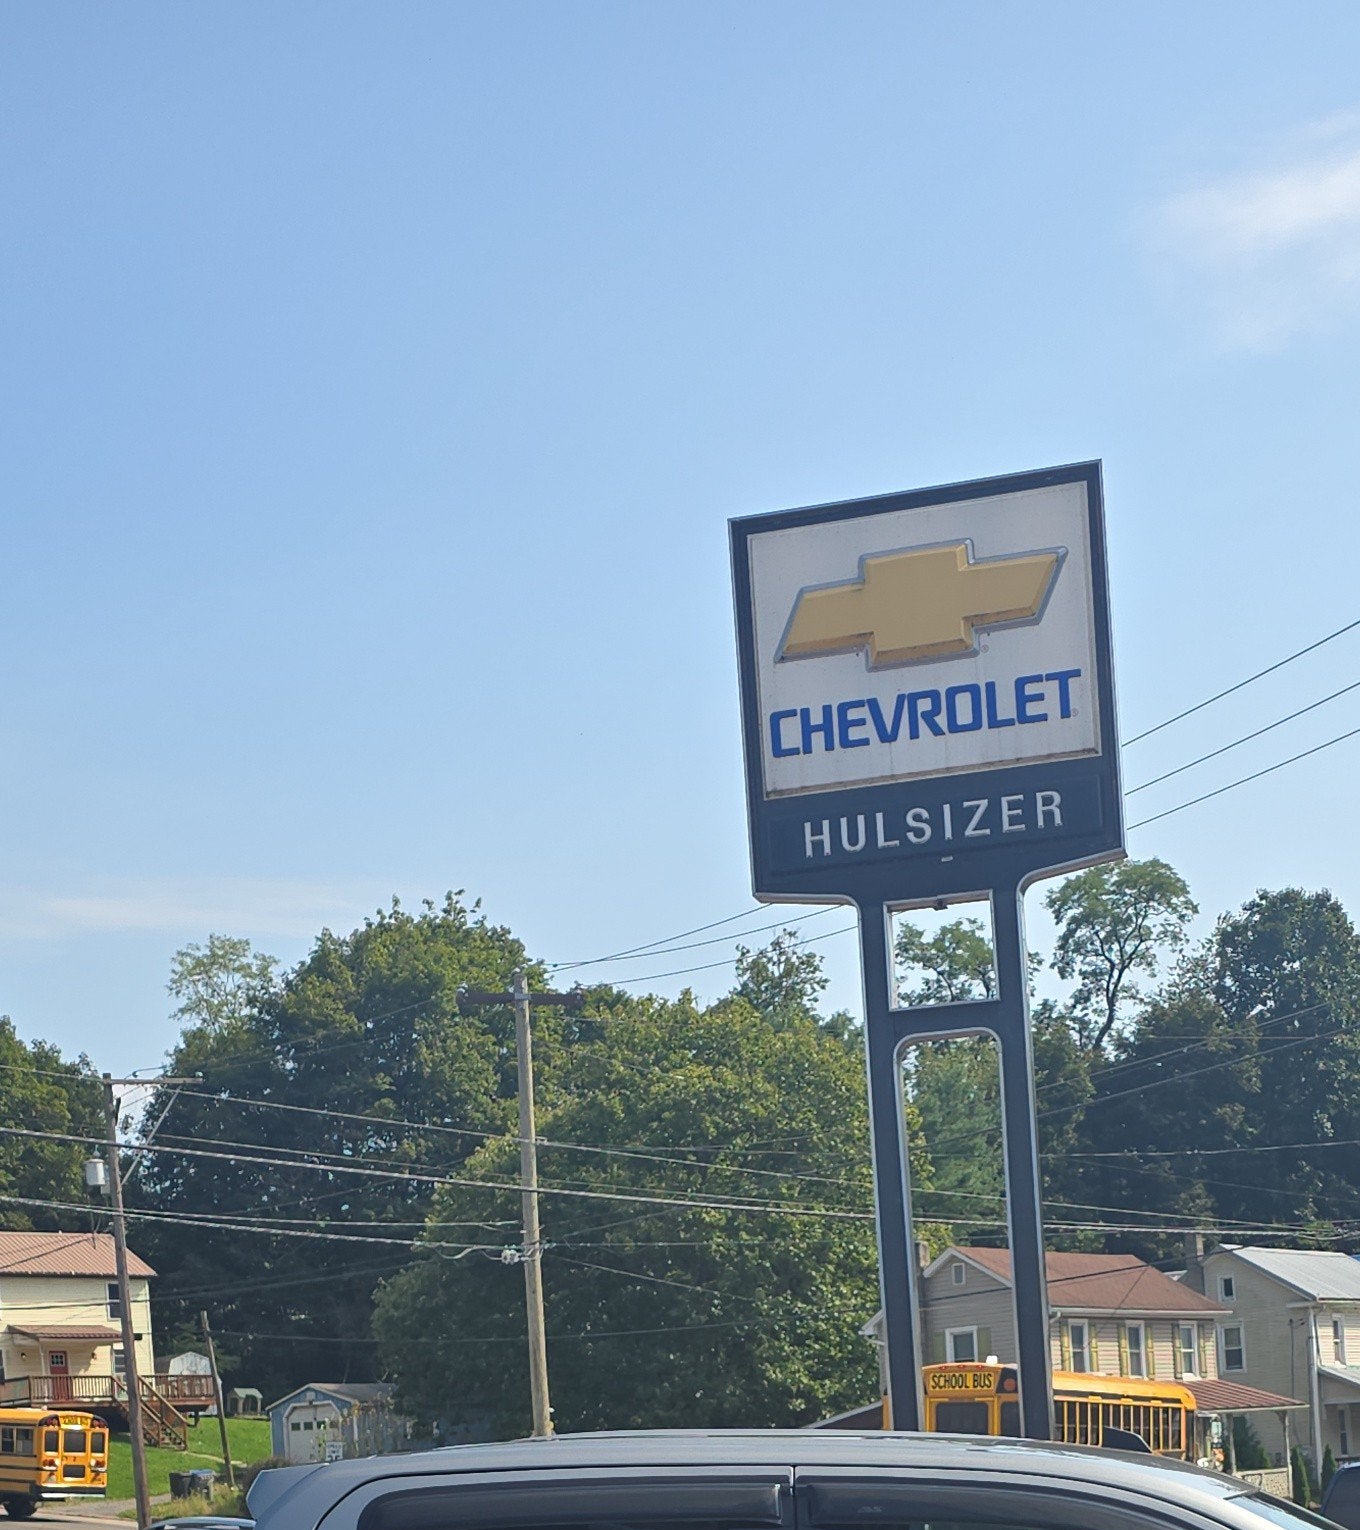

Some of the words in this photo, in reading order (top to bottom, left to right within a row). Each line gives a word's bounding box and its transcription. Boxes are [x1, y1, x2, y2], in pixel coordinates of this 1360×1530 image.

[770, 668, 1082, 758] CHEVROLET
[803, 790, 1065, 858] HULSIZER
[931, 1374, 969, 1389] SCHOOL
[973, 1373, 992, 1389] BUS
